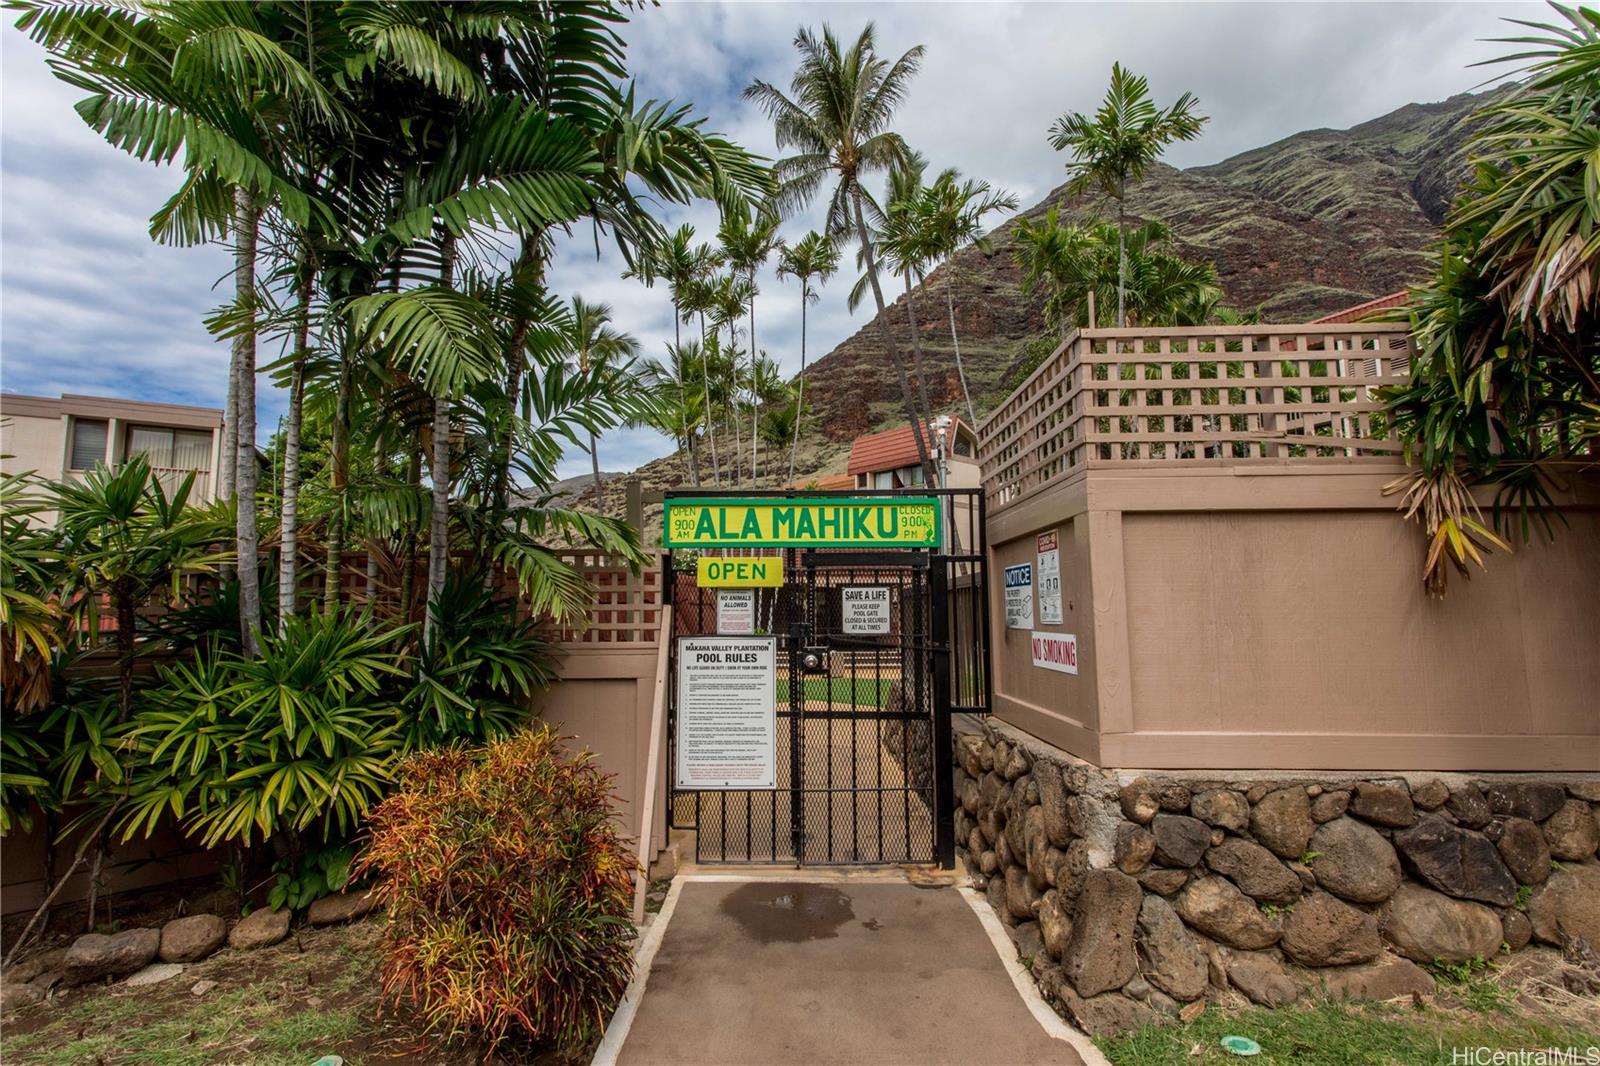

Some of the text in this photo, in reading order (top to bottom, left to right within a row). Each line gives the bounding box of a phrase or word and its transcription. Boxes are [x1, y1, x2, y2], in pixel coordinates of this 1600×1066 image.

[672, 506, 696, 516] OPEN
[899, 505, 931, 515] CLOSED
[694, 507, 899, 539] ALA MAHIKU
[677, 531, 690, 539] AM
[903, 530, 918, 539] PM
[708, 562, 766, 580] OPEN
[1006, 567, 1030, 586] NOTICE
[844, 590, 887, 600] SAVE A LIFE
[1033, 638, 1075, 666] NO SMOKING
[696, 653, 758, 663] POOL RULES
